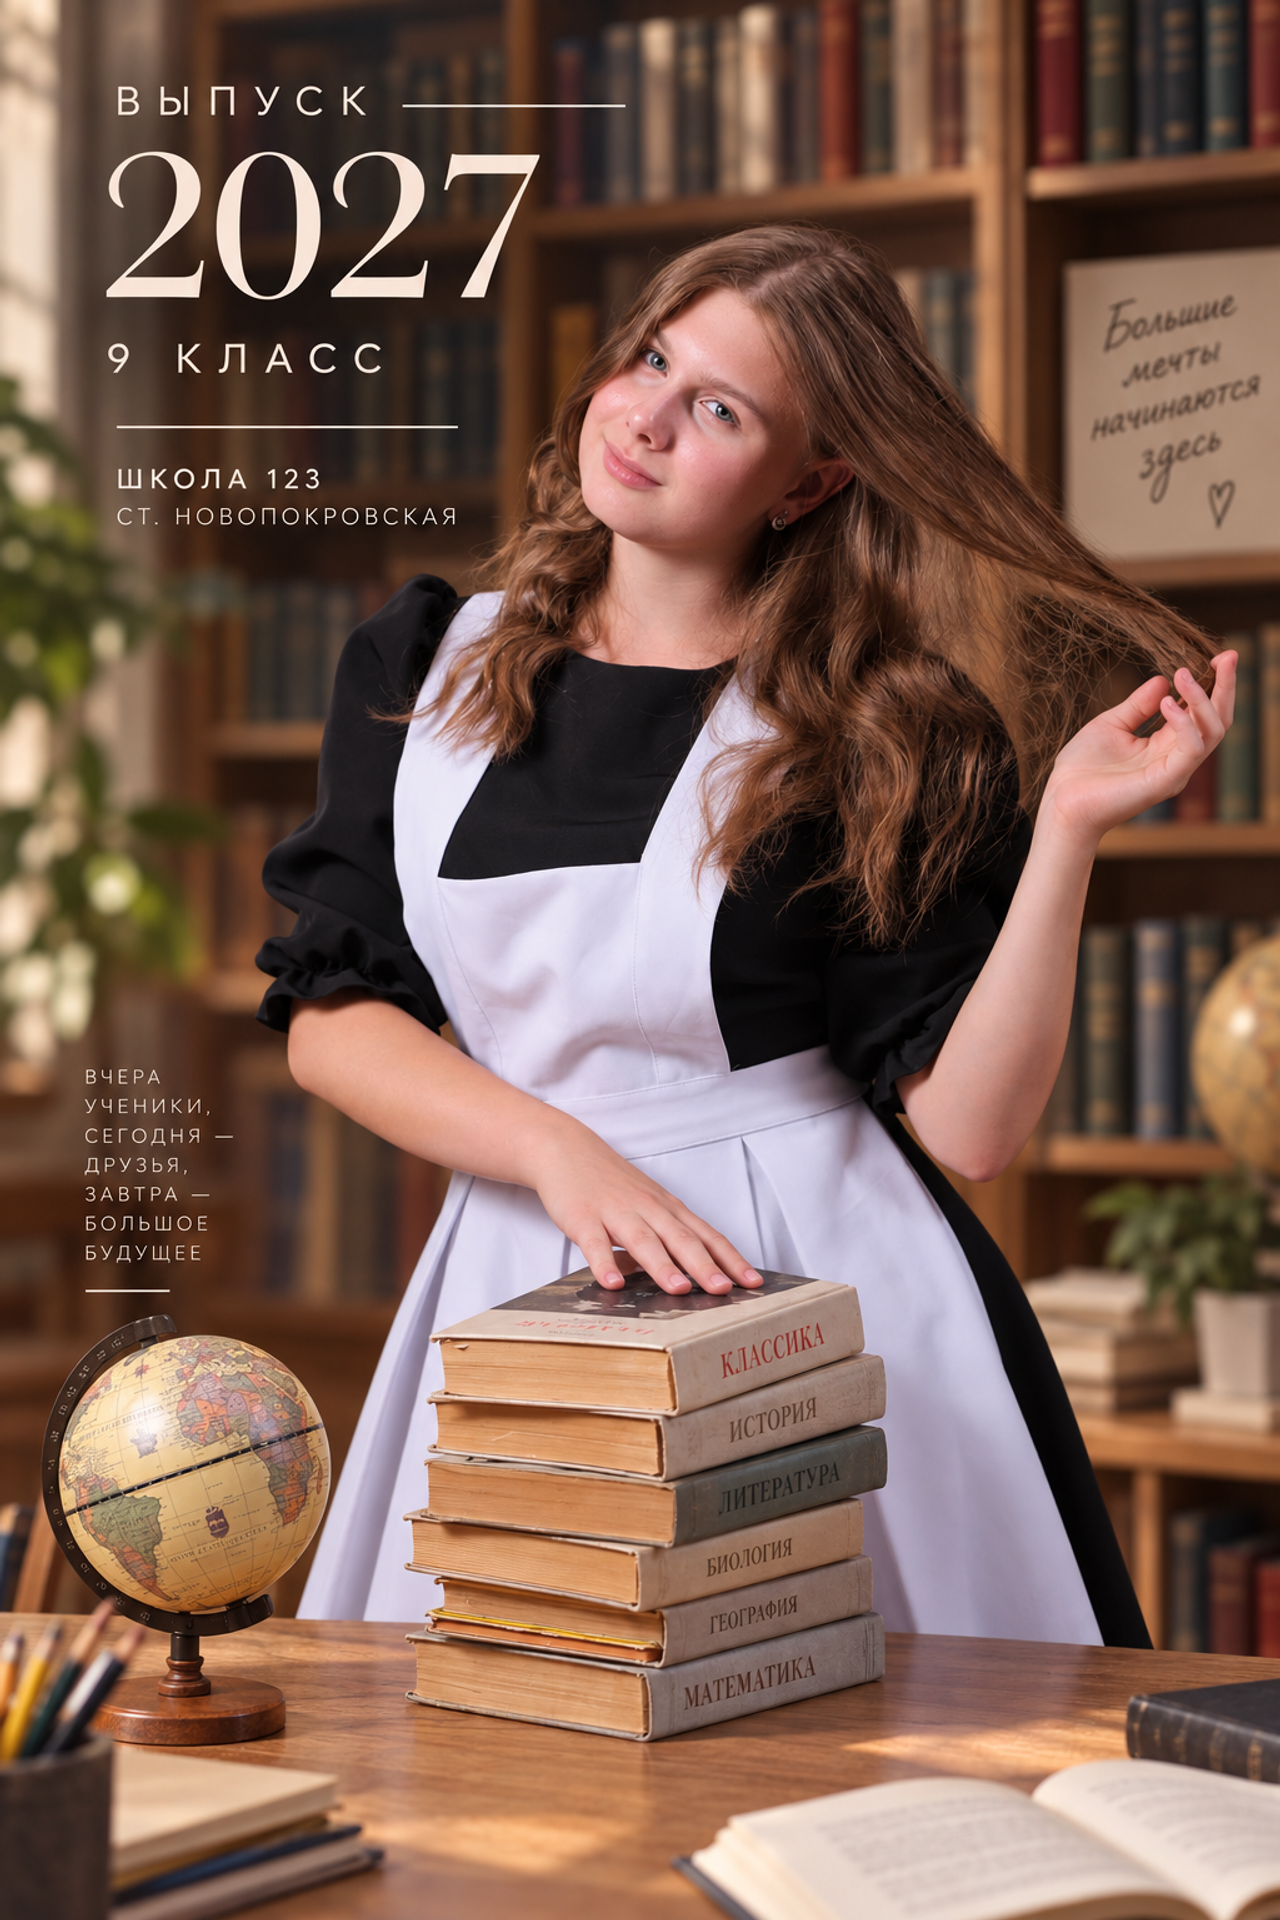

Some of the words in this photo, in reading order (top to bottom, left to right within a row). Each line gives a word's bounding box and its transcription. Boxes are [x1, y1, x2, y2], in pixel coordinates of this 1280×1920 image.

[1103, 295, 1238, 352] Большие
[1121, 341, 1221, 388] мечты
[1091, 374, 1261, 441] начинаются
[1138, 431, 1222, 504] здесь
[720, 1322, 825, 1379] КЛАССИКА
[728, 1396, 818, 1444] ИСТОРИЯ
[718, 1462, 841, 1515] ЛИТЕРАТУРА
[706, 1537, 793, 1577] БИОЛОГИЯ
[709, 1594, 798, 1635] ГЕОГРАФИЯ
[684, 1655, 816, 1710] МАТЕМАТИКА
